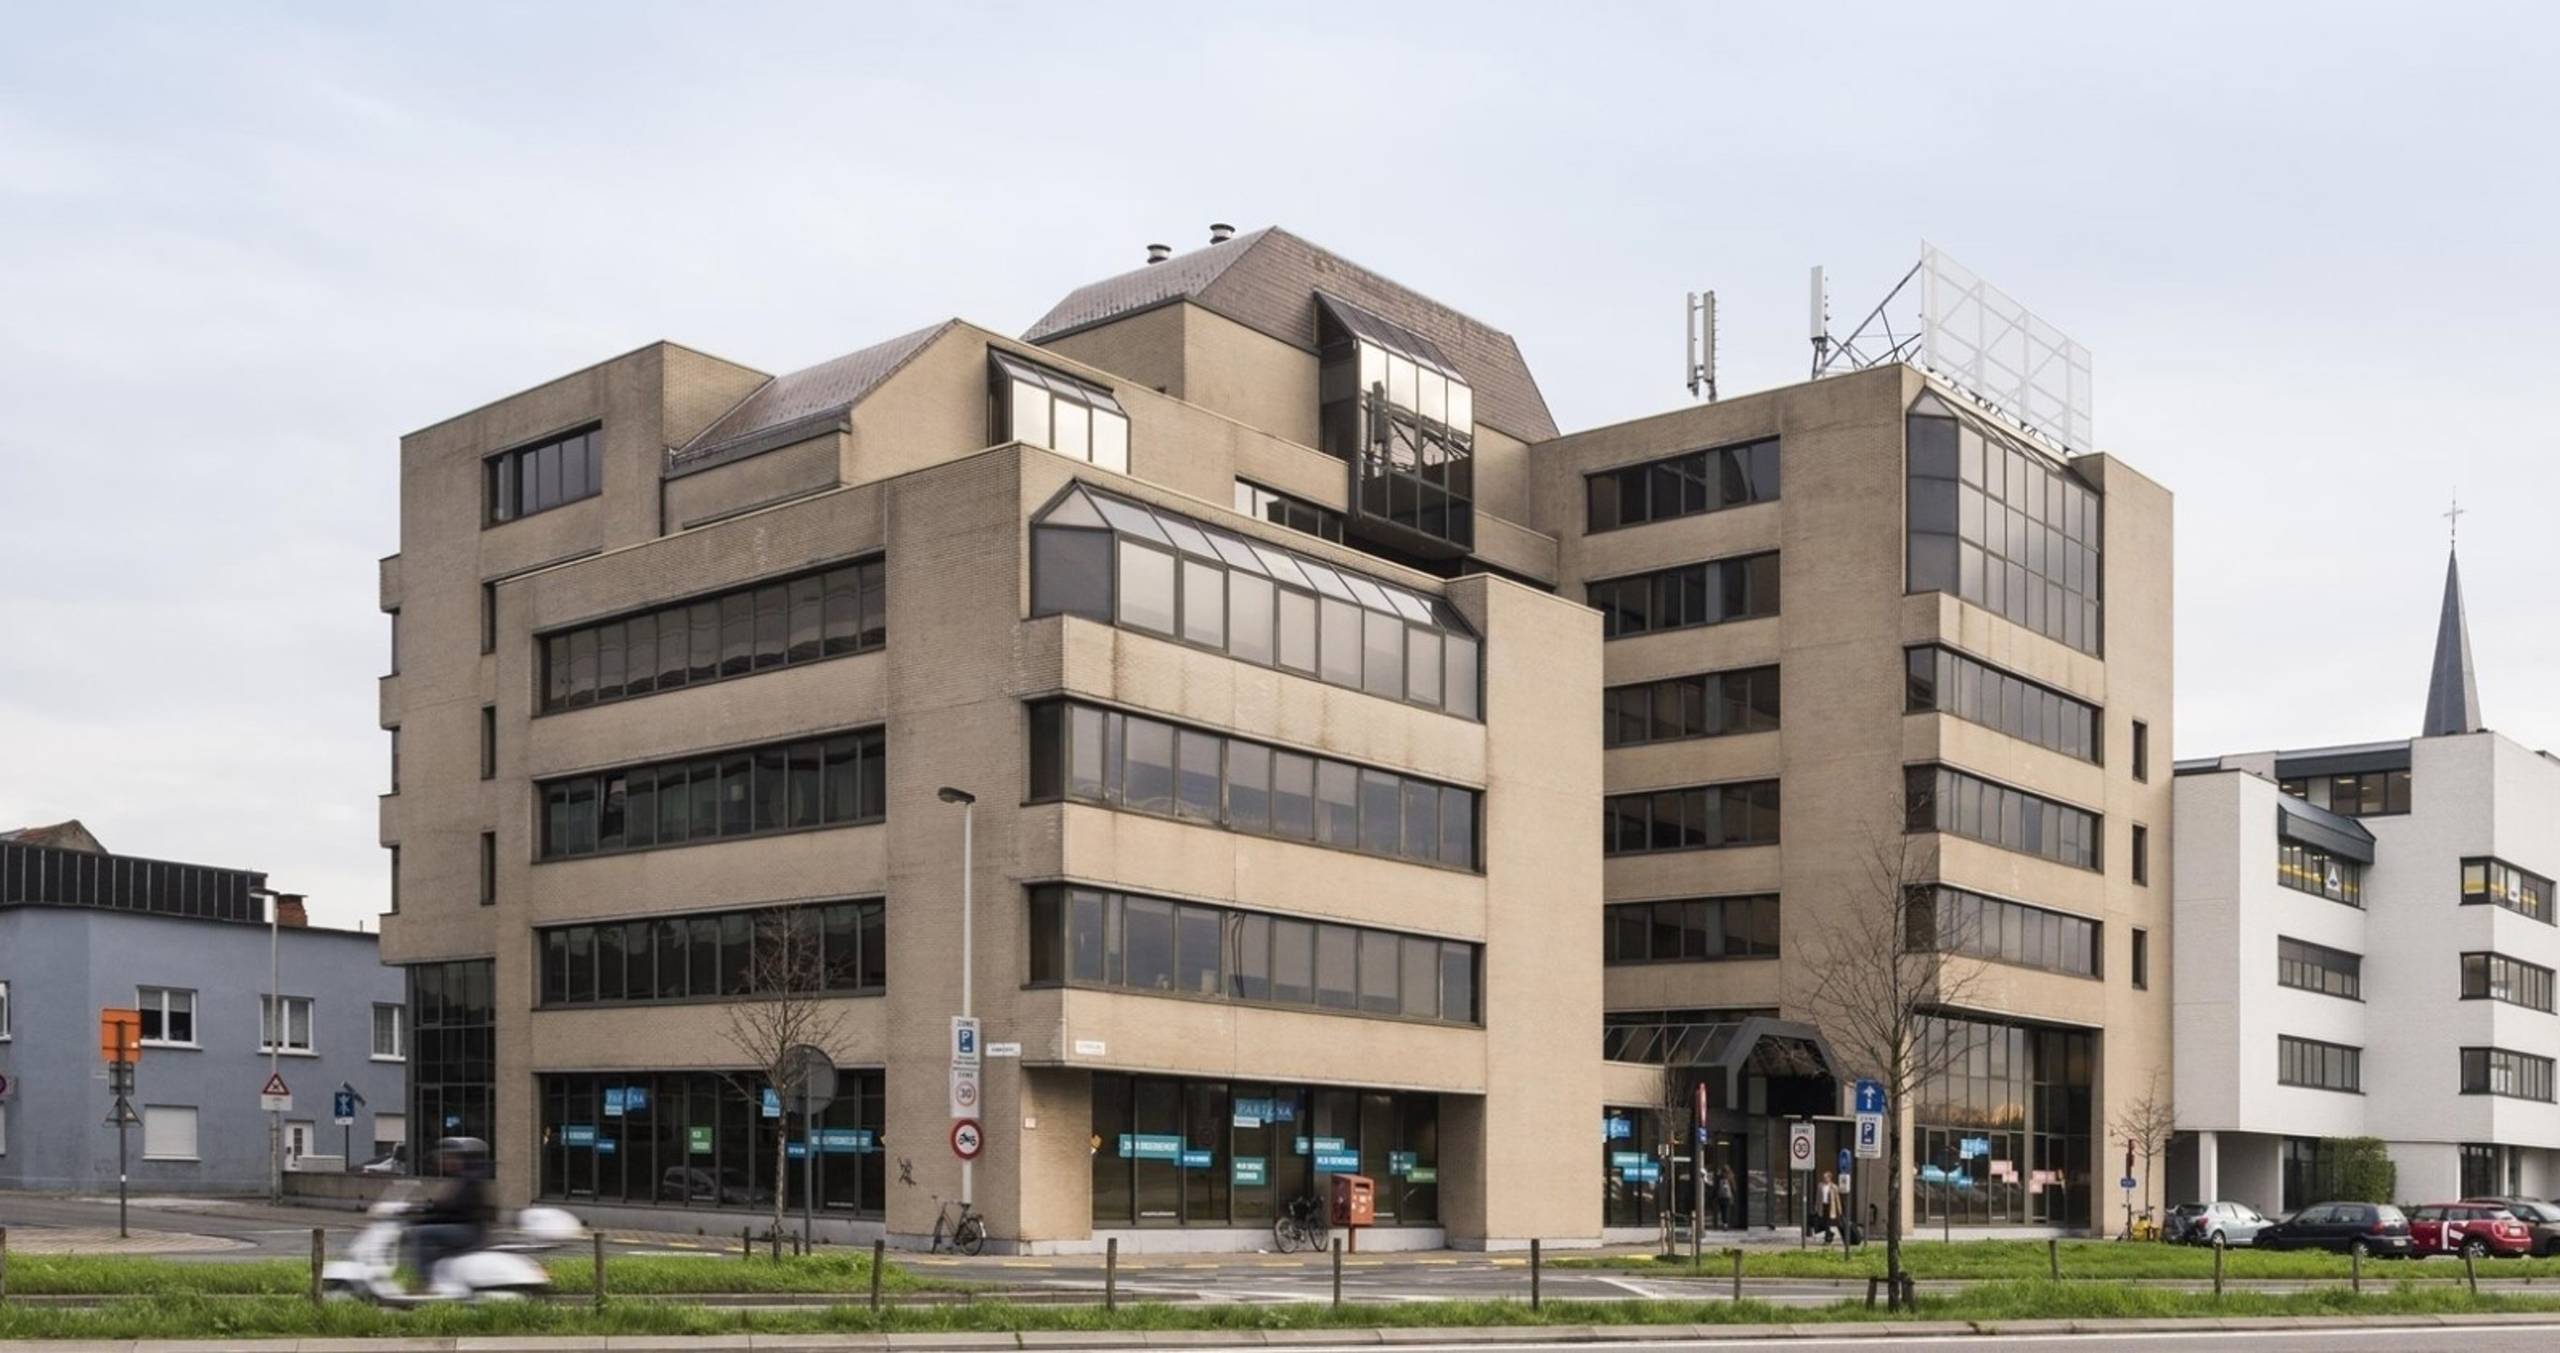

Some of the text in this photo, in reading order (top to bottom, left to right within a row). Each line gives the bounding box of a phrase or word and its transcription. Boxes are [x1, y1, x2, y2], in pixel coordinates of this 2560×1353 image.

[962, 1031, 970, 1042] P
[961, 1088, 972, 1098] 30
[1864, 1125, 1872, 1135] P
[1794, 1142, 1808, 1154] 30
